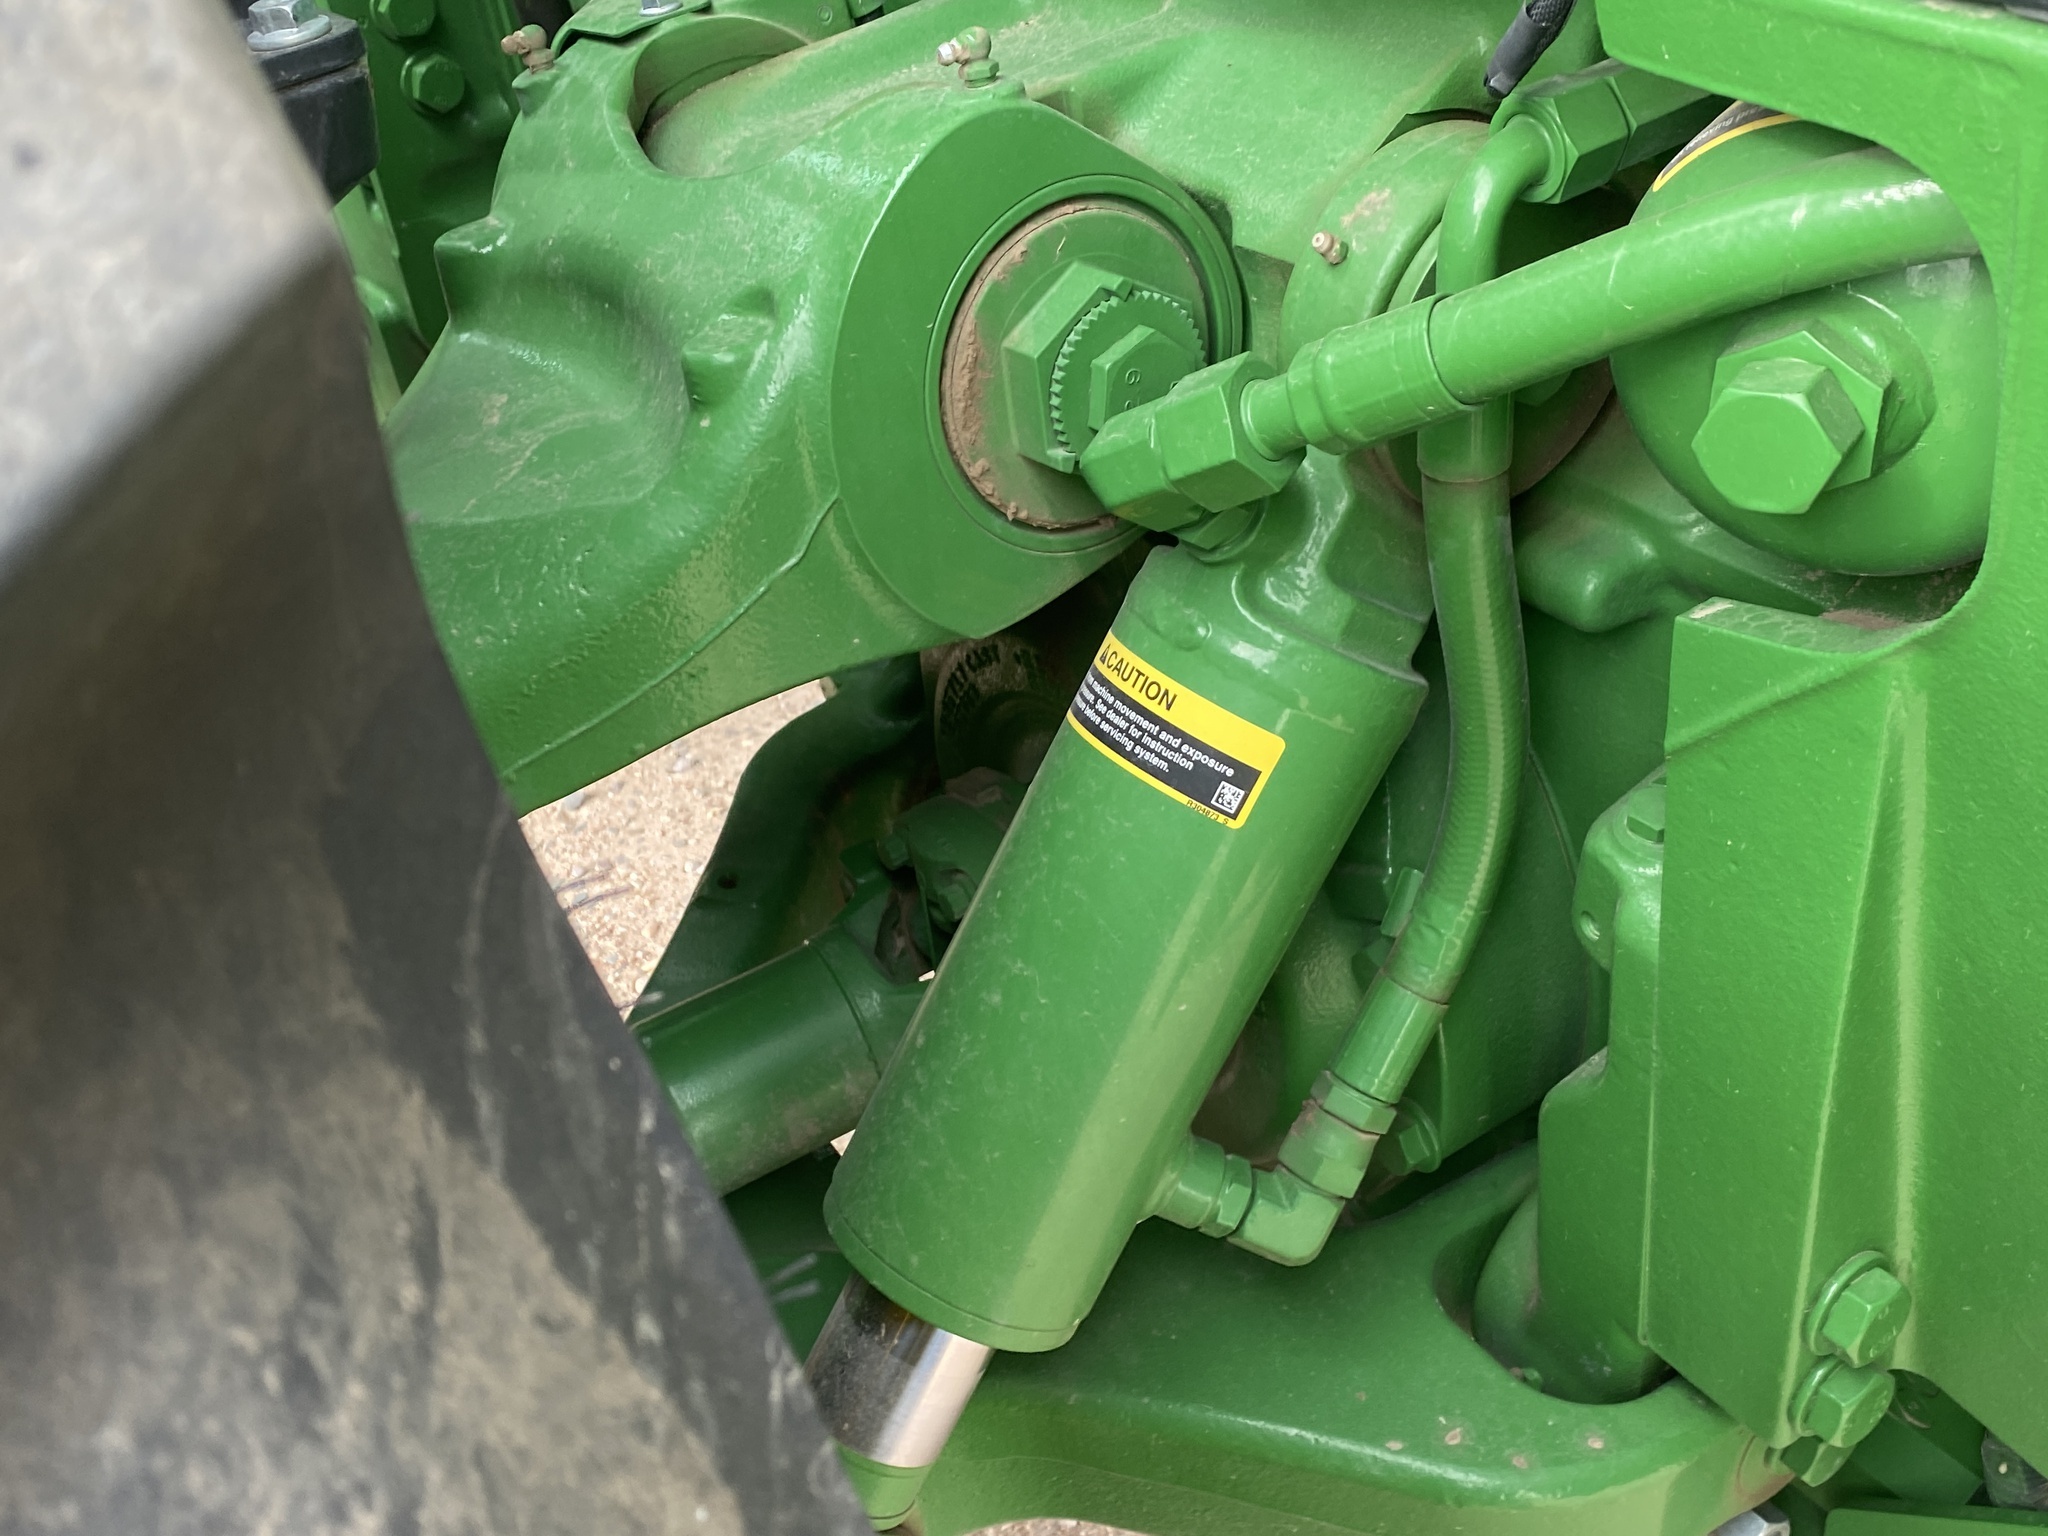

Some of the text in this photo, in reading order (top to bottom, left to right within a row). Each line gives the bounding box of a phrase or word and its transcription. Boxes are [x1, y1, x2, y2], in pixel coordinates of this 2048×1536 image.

[1106, 650, 1178, 711] CAUTION
[1084, 704, 1170, 773] before servicing system.
[1092, 681, 1115, 704] machine
[1113, 700, 1160, 735] movement
[1158, 731, 1182, 748] and
[1181, 744, 1235, 777] exposure
[1095, 698, 1108, 714] See
[1106, 709, 1130, 730] dealer
[1128, 724, 1143, 739] for
[1141, 732, 1194, 771] instruction
